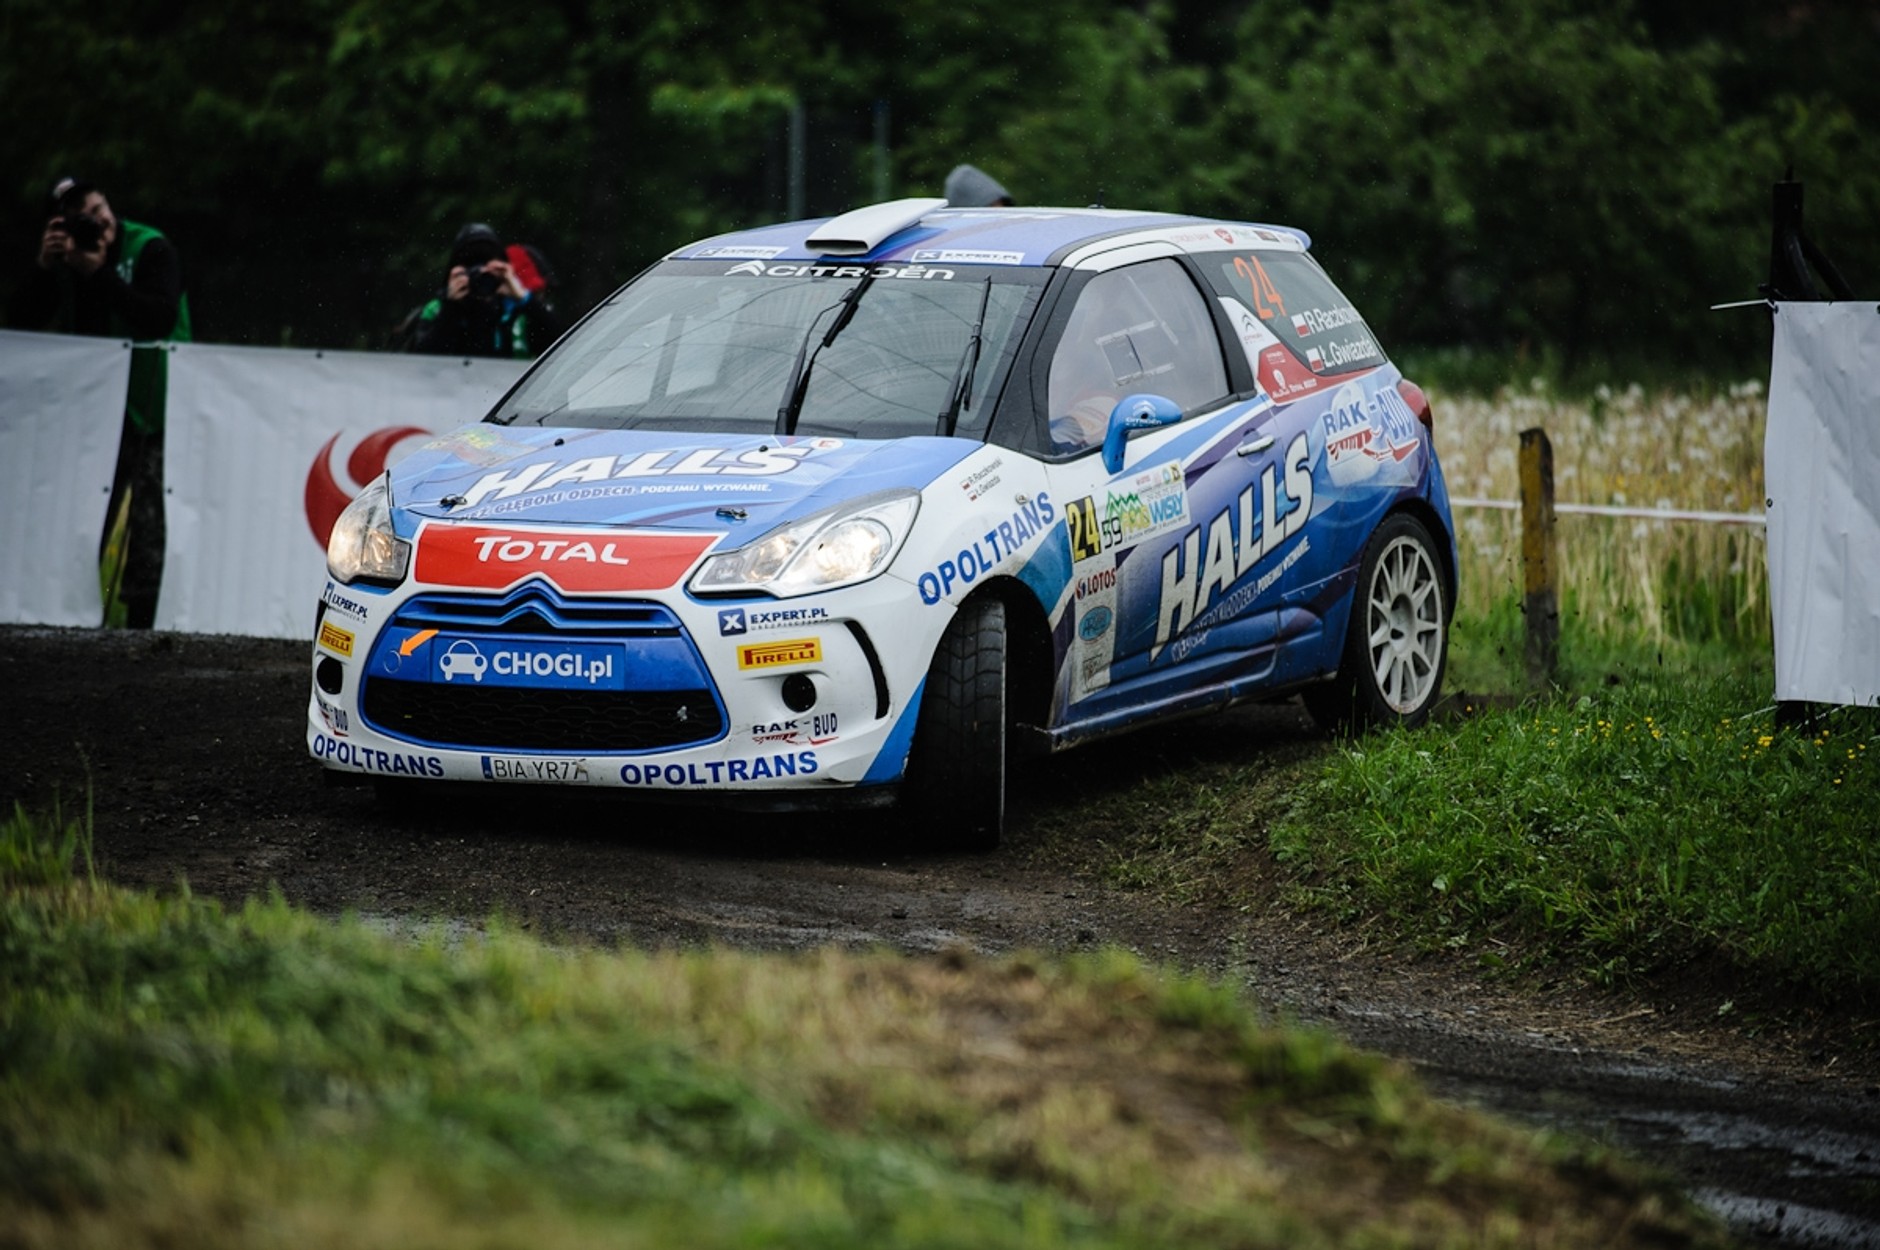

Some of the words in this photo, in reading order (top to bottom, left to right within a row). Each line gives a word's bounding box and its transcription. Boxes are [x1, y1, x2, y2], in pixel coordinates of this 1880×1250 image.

[1233, 255, 1287, 320] 24
[447, 446, 812, 514] HALLS
[1066, 495, 1102, 562] 24
[1151, 431, 1314, 663] HALLS
[474, 535, 630, 566] TOTAL
[917, 491, 1056, 607] OPOLTRANS
[1087, 567, 1117, 596] LOTOS
[749, 607, 829, 625] EXPERT.PL
[743, 642, 816, 666] PIRELLI
[312, 733, 445, 778] OPOLTRANS
[493, 759, 528, 779] BIA
[619, 750, 819, 786] OPOLTRANS
